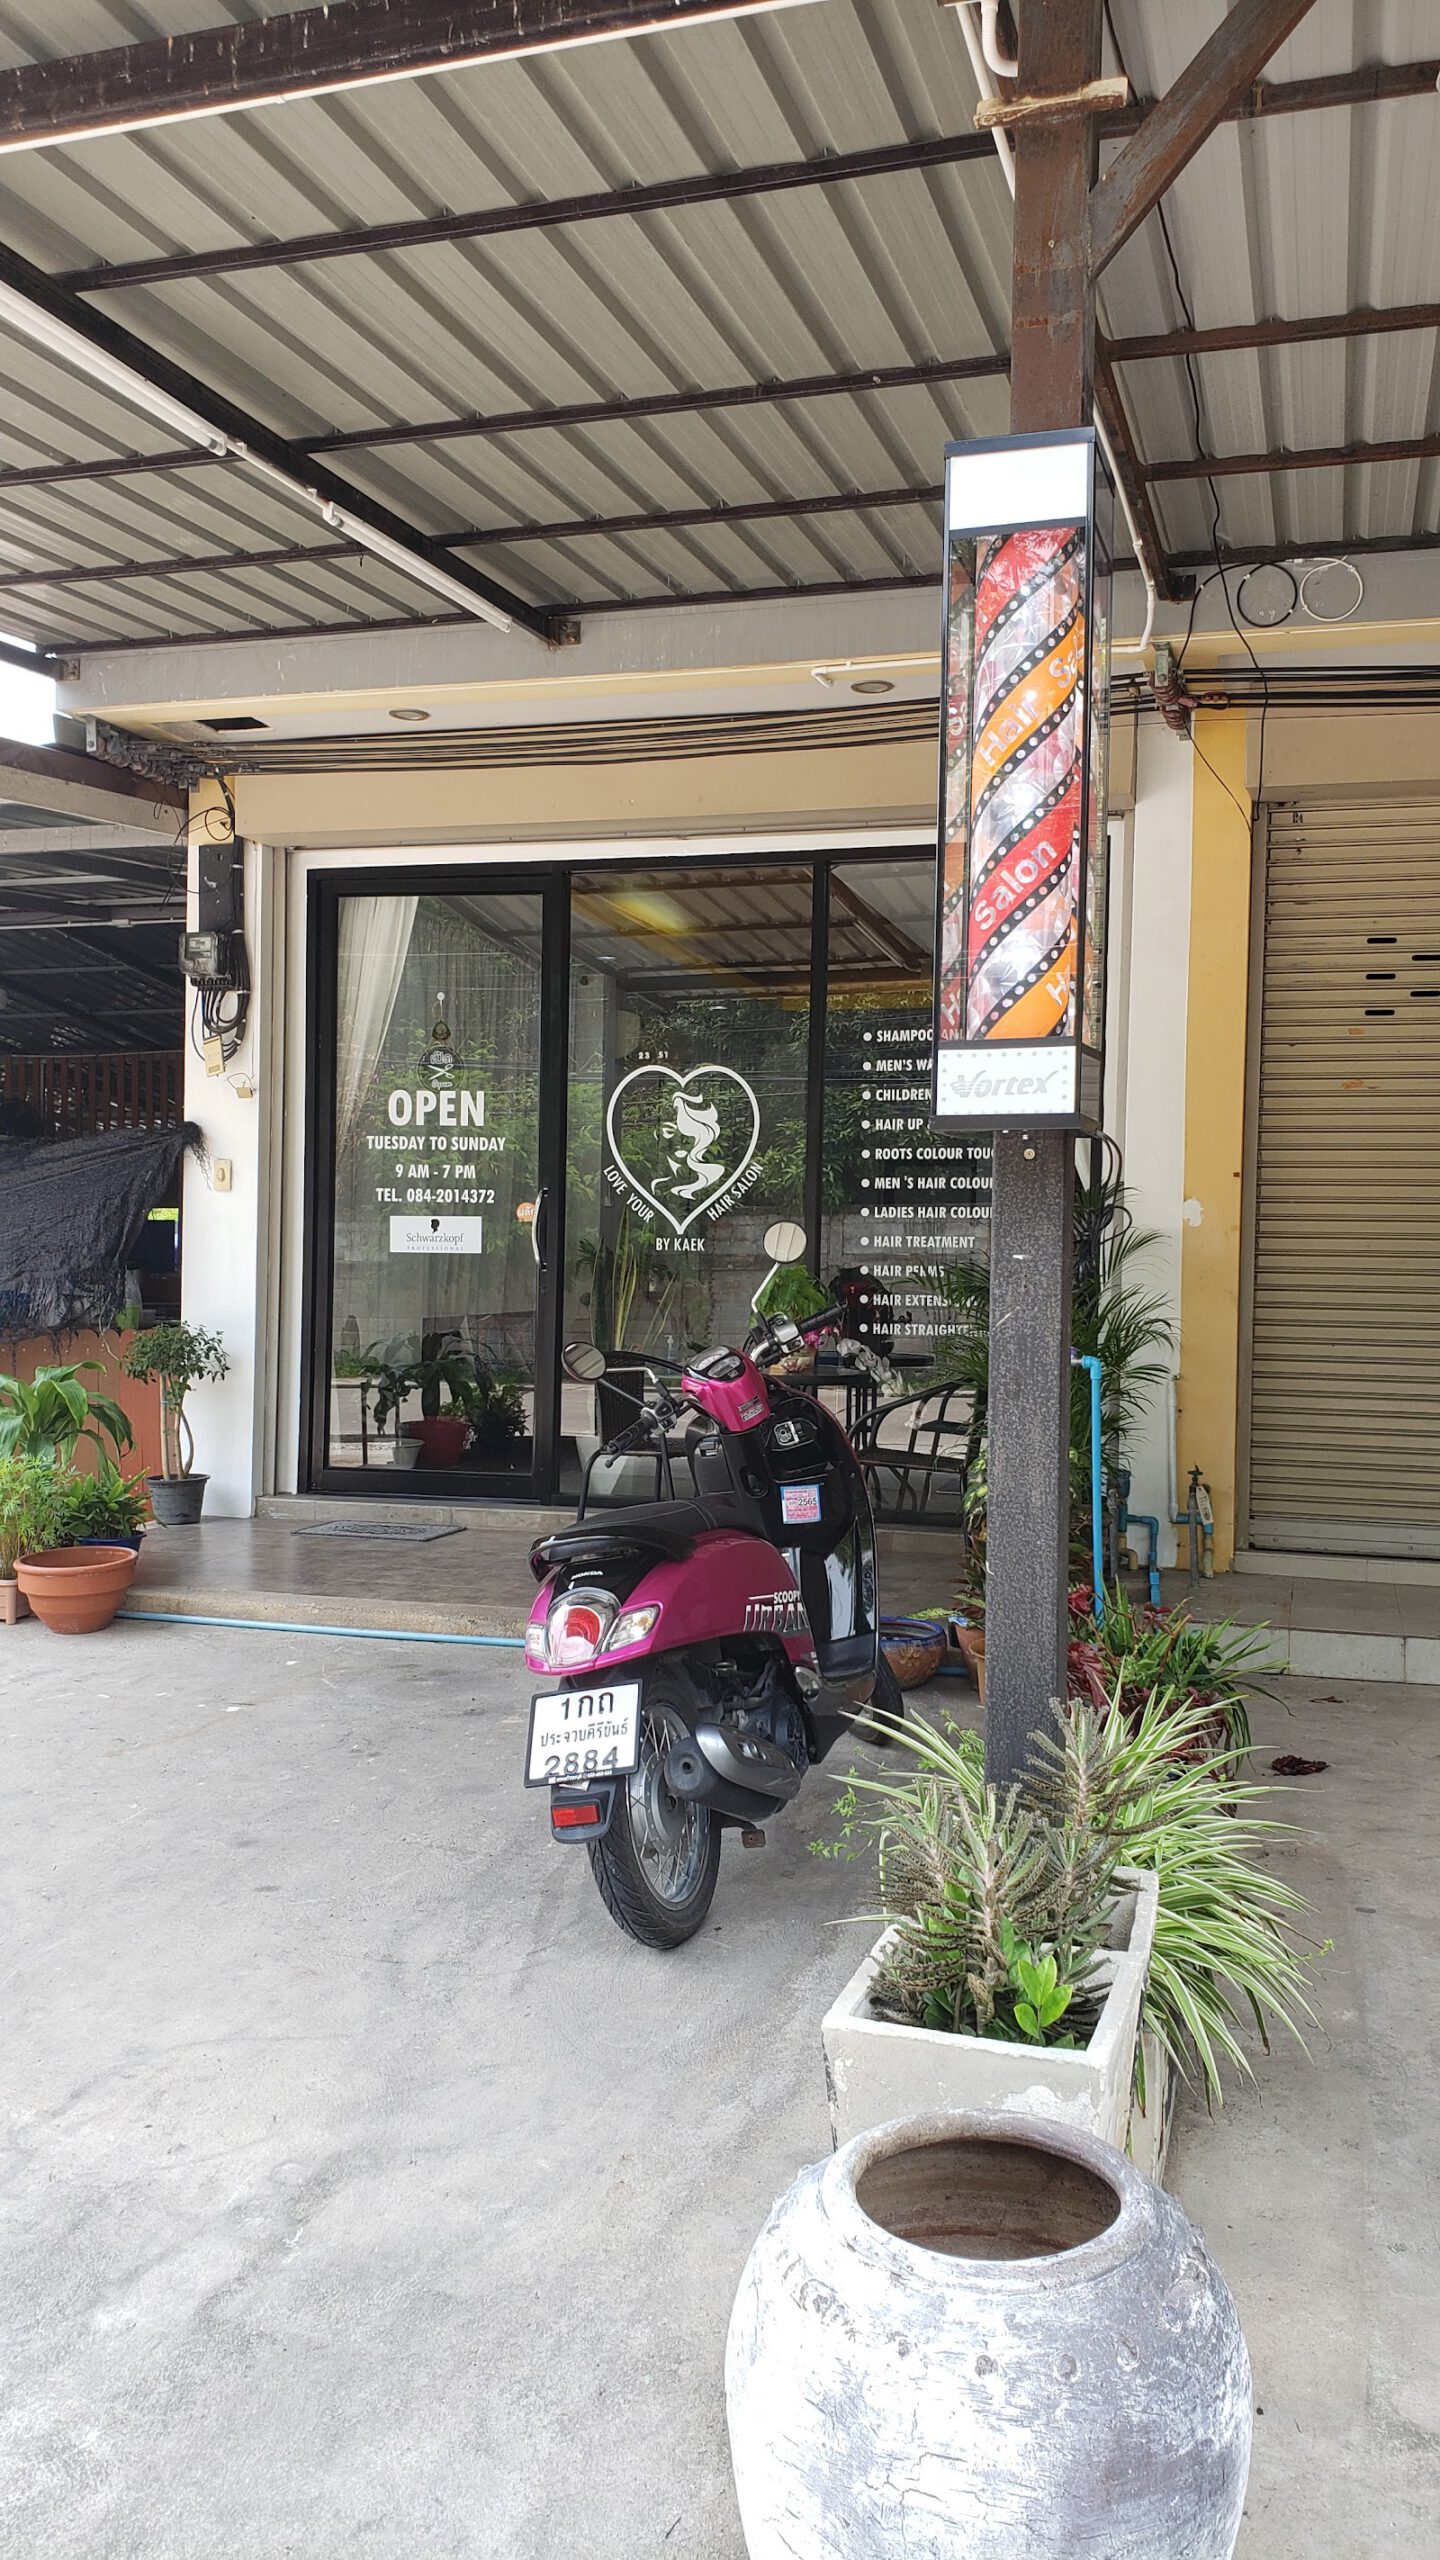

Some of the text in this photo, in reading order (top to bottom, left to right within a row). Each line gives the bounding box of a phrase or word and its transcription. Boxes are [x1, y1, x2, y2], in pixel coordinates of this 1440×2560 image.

[979, 692, 1038, 767] Hair
[975, 841, 1057, 930] Salon
[875, 1059, 913, 1072] MEN'S
[950, 1070, 1059, 1098] Vortex
[875, 1088, 932, 1102] CHILDREN
[388, 1089, 485, 1127] OPEN
[875, 1118, 904, 1131] HAIR
[907, 1118, 924, 1131] UP
[366, 1135, 507, 1151] TUESDAY TO SUNDAY
[875, 1147, 913, 1160] ROOTS
[916, 1147, 963, 1160] COLOUR
[395, 1163, 403, 1178] 9
[407, 1164, 430, 1178] AM
[442, 1164, 450, 1179] 7
[455, 1165, 476, 1179] PM
[917, 1177, 946, 1190] HAIR
[376, 1187, 495, 1204] TEL. 084-2014372
[603, 1165, 655, 1223] LOVE YOUR
[706, 1161, 764, 1222] HAIR SALON
[874, 1206, 914, 1219] LADIES
[917, 1206, 946, 1219] HAIR
[406, 1232, 465, 1246] Schwarzkopf
[655, 1238, 705, 1252] BY KAEK
[873, 1235, 975, 1249] HAIR TREATMENT
[873, 1264, 902, 1277] HAIR
[872, 1294, 902, 1306] HAIR
[872, 1322, 901, 1335] HAIR
[798, 1498, 817, 1506] 2565
[571, 1570, 603, 1580] HONDA
[540, 1717, 629, 1747] ประจวบคีรีขันธ์
[544, 1746, 618, 1778] 2884
